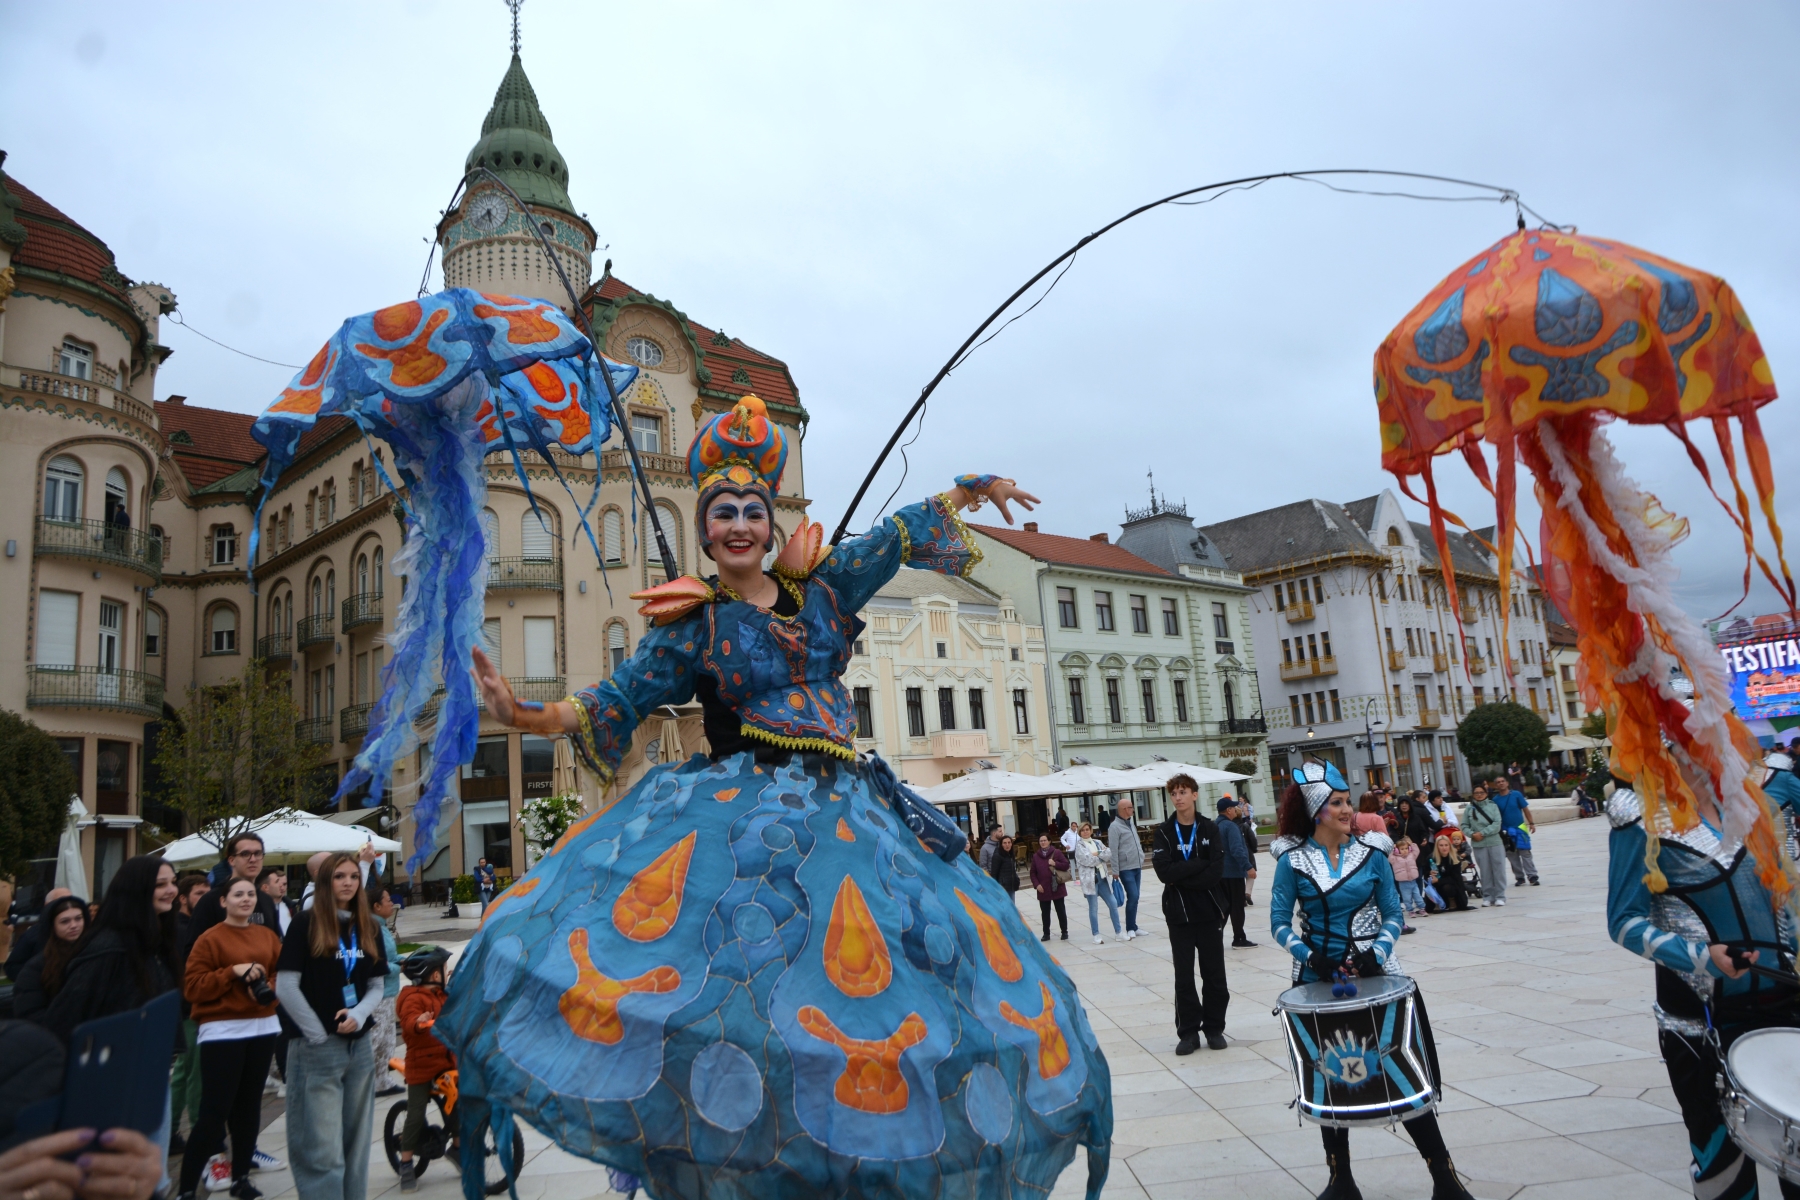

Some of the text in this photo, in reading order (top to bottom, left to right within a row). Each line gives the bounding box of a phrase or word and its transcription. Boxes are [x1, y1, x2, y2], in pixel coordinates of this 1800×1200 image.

[1721, 638, 1800, 674] FESTIFA
[1219, 747, 1259, 758] ALPHA BANK
[1271, 741, 1336, 754] BANCA TRANSILVANIA
[1347, 1060, 1363, 1079] K
